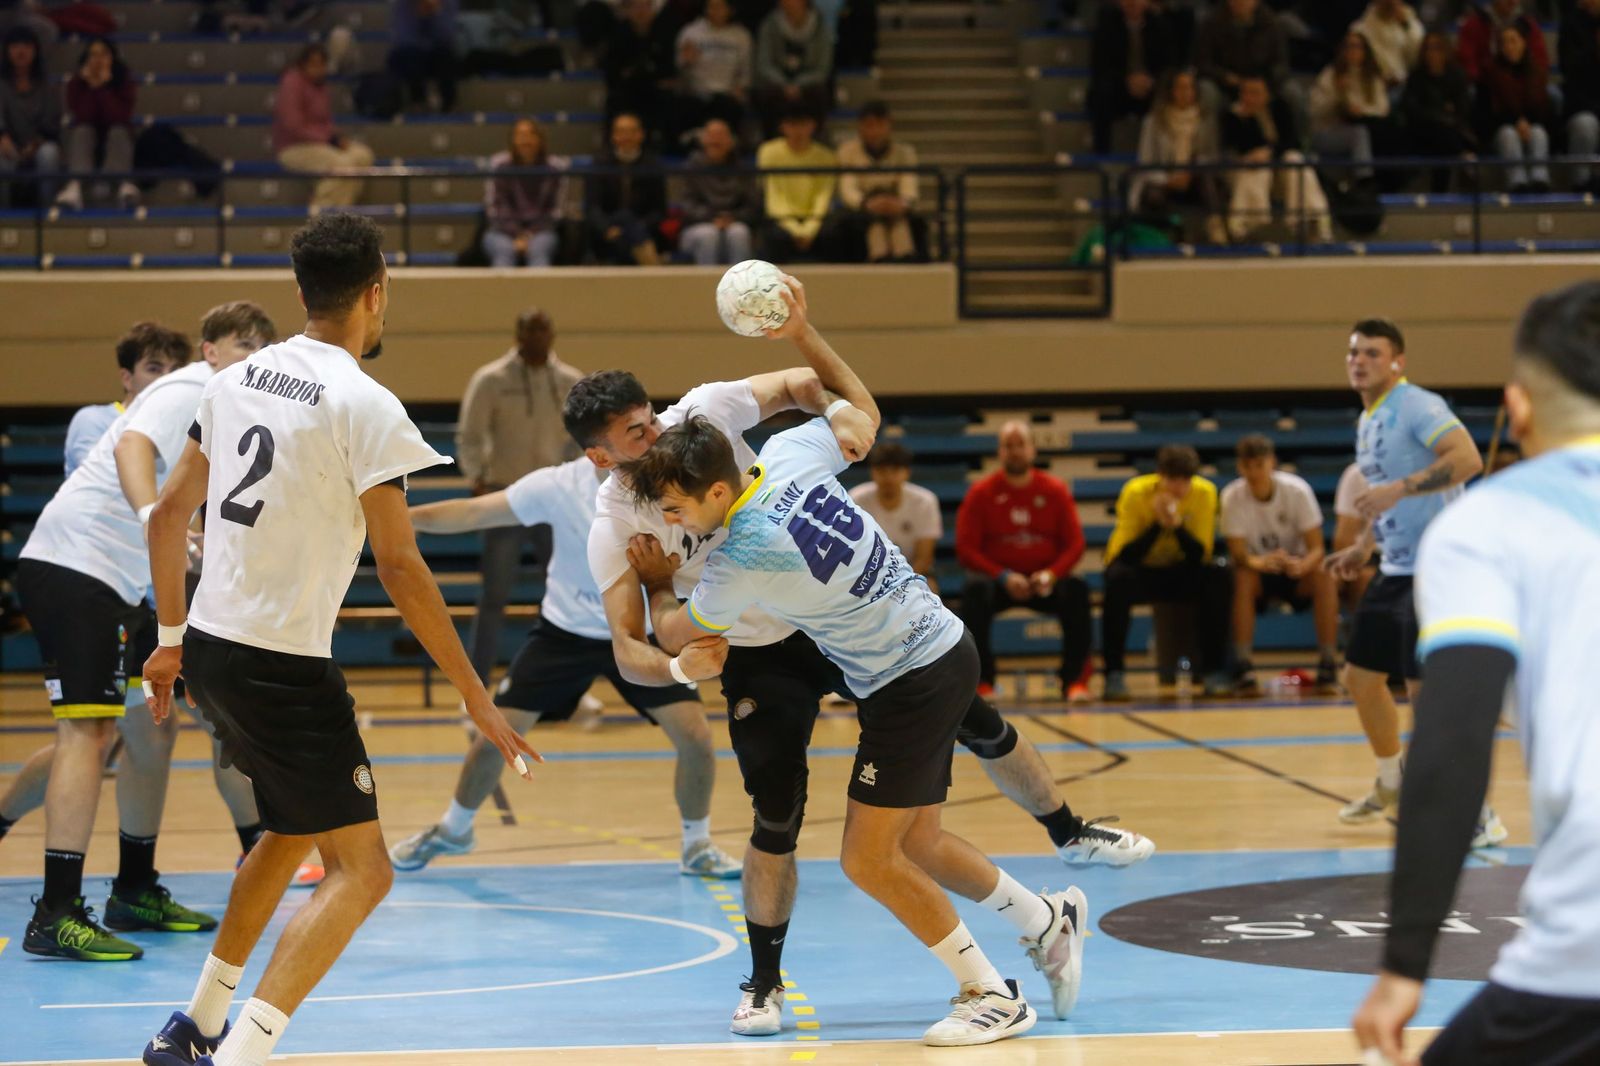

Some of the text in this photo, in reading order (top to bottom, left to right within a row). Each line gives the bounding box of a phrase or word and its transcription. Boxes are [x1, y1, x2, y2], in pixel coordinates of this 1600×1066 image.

[240, 363, 326, 406] M.BARRIOS
[220, 424, 275, 528] 2
[766, 480, 804, 526] A.SANZ
[786, 484, 864, 585] 46
